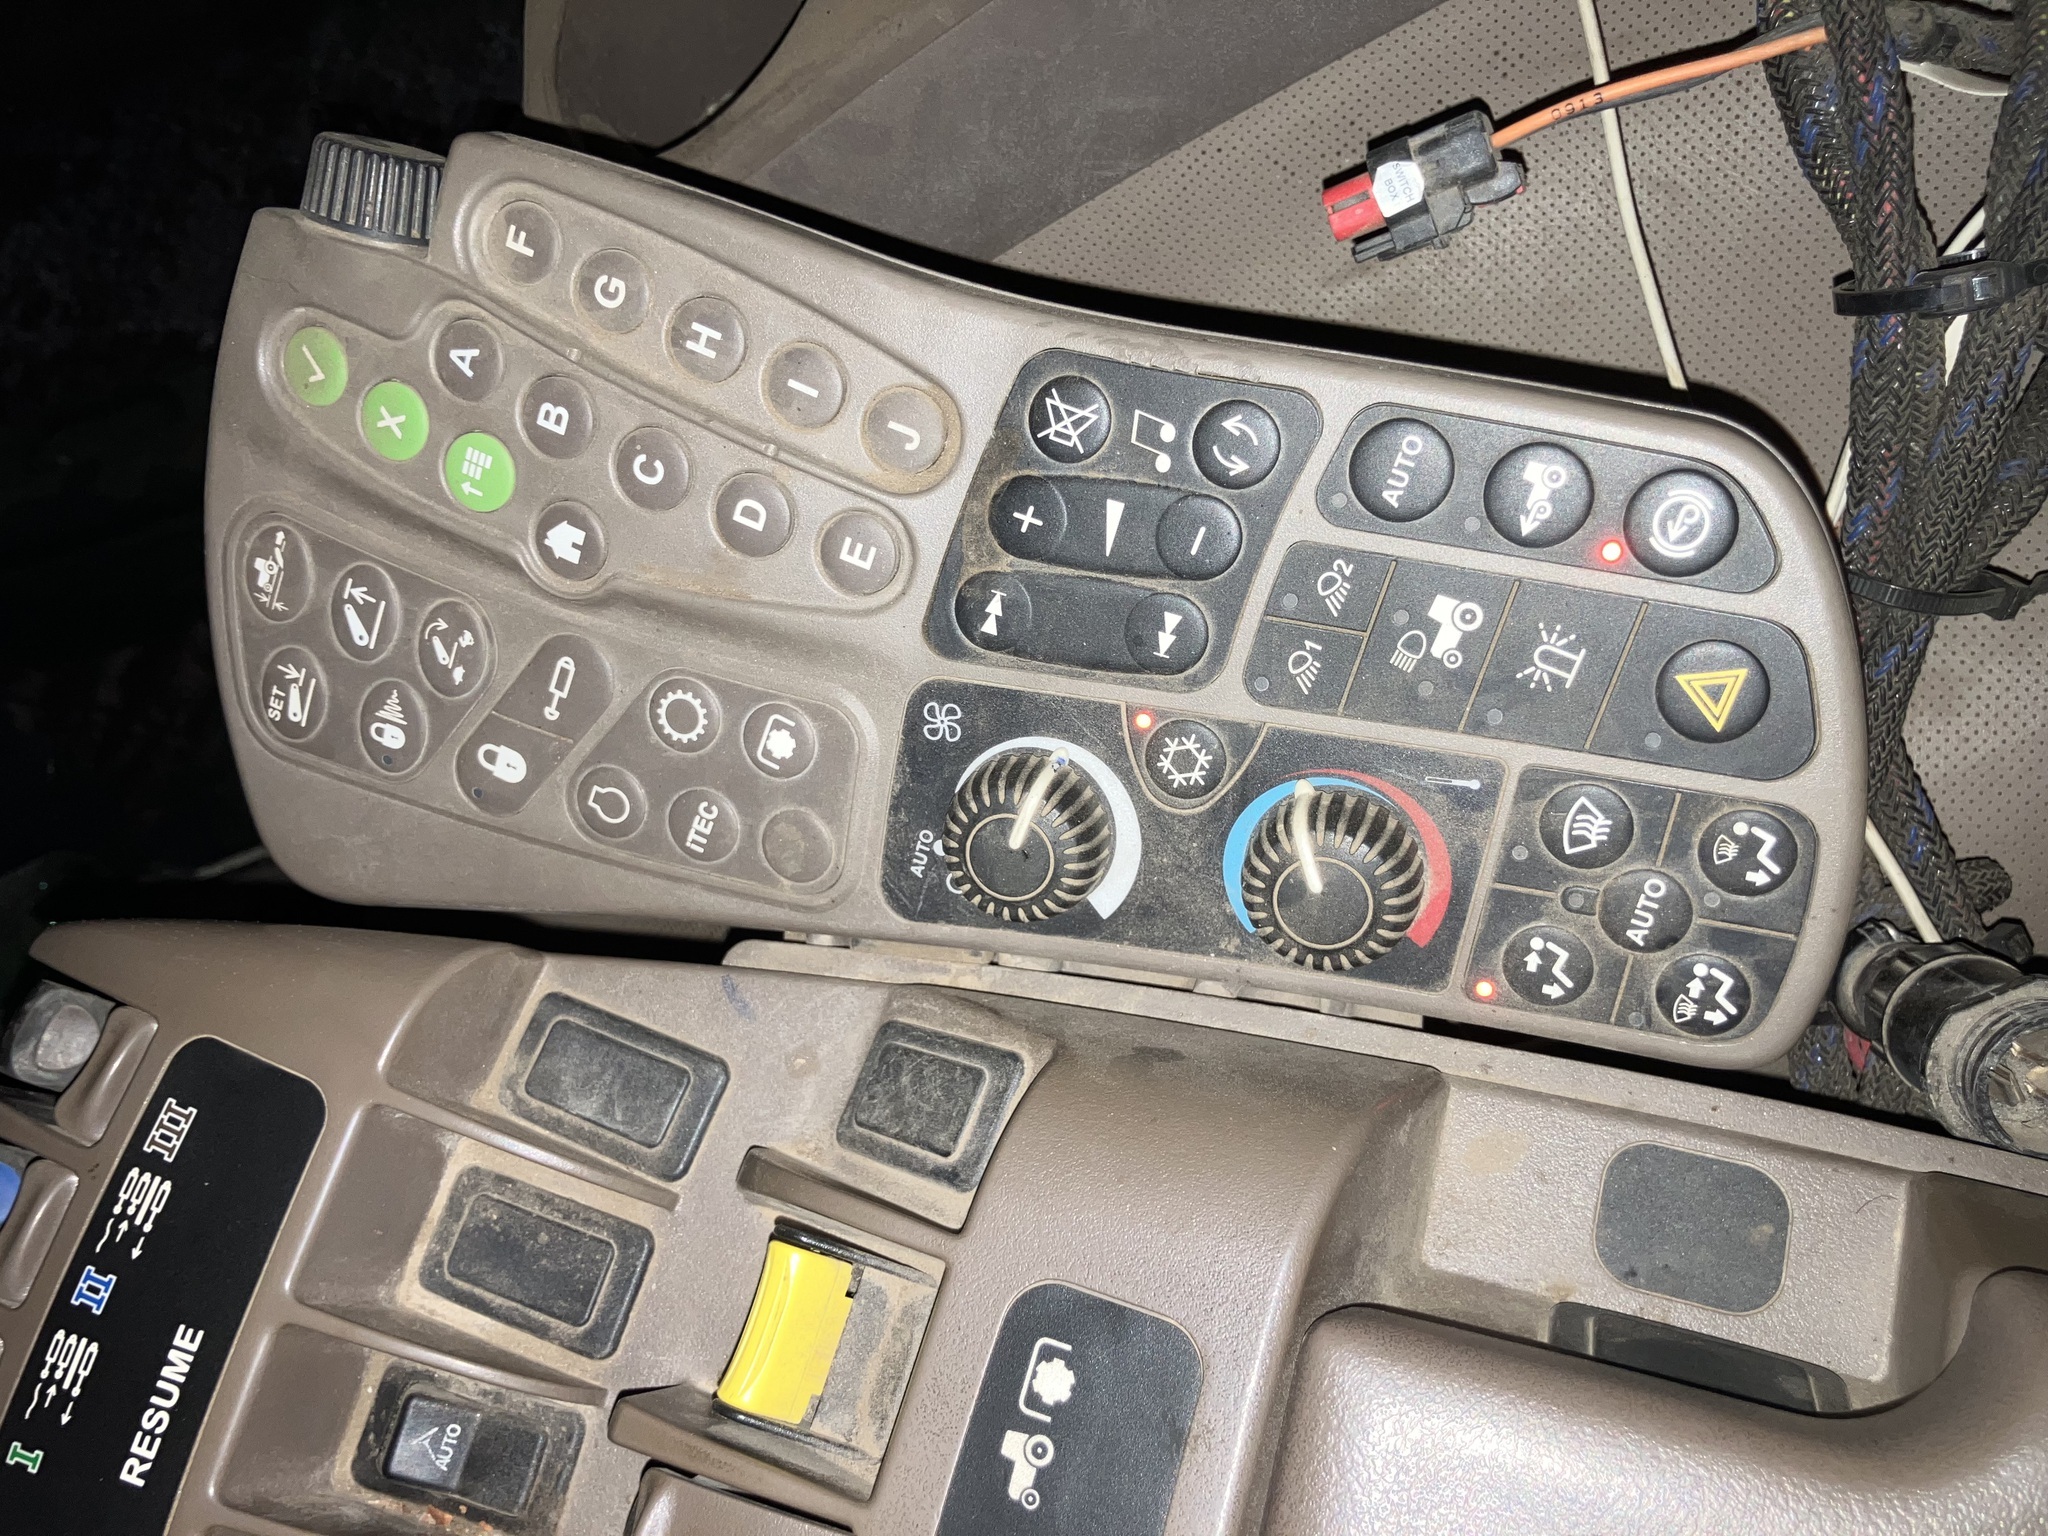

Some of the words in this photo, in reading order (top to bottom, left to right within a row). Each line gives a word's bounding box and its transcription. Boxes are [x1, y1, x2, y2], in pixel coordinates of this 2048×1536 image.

[1384, 178, 1400, 202] BOX
[1392, 162, 1415, 203] SWITCH
[505, 224, 536, 258] F
[593, 274, 627, 309] G
[685, 321, 724, 360] H
[448, 347, 482, 379] A
[787, 378, 820, 399] I
[536, 401, 571, 436] B
[887, 420, 922, 451] J
[632, 453, 666, 487] C
[1381, 434, 1423, 509] AUTO
[732, 497, 768, 532] D
[839, 536, 878, 571] E
[1333, 559, 1354, 577] 2
[1304, 639, 1322, 651] 1
[267, 684, 287, 722] SET
[685, 800, 720, 855] iTEC
[910, 829, 934, 879] AUTO
[1625, 878, 1667, 947] AUTO
[143, 1097, 197, 1162] III
[70, 1265, 117, 1315] II
[119, 1323, 205, 1488] RESUME
[5, 1441, 44, 1475] I
[434, 1422, 463, 1472] AUTO
